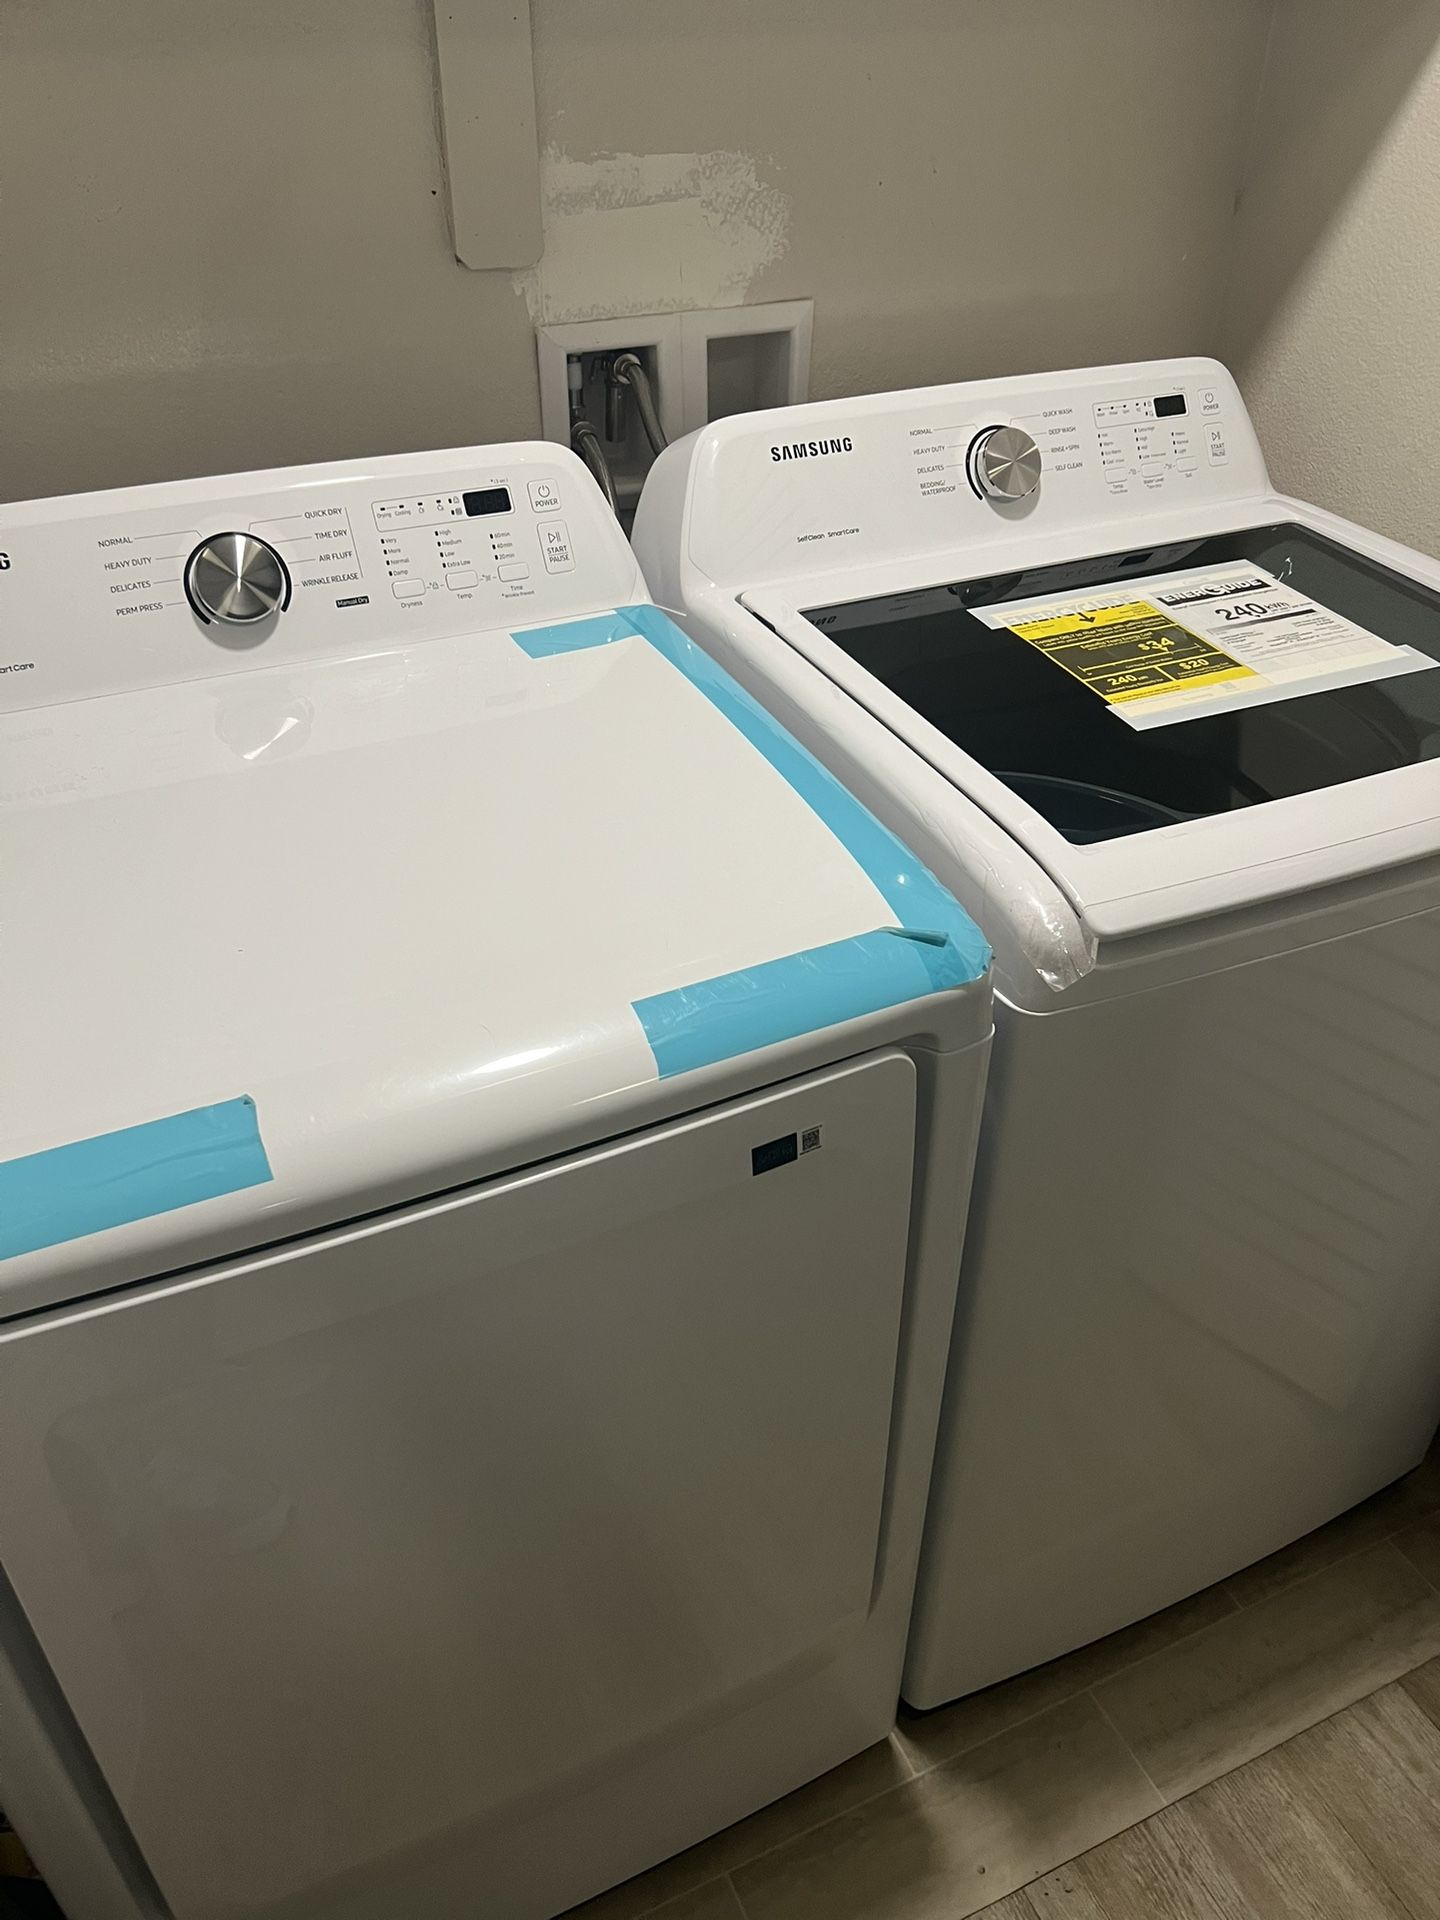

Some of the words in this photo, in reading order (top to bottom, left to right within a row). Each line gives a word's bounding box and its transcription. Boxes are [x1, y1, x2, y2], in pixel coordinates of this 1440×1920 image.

[909, 428, 933, 437] NORMAL
[770, 437, 853, 462] SAMSUNG
[913, 447, 932, 456] HEAVY
[932, 445, 946, 453] DUTY
[916, 464, 945, 474] DELICATES
[921, 485, 957, 497] WATERPROOF
[534, 497, 558, 508] POWER
[304, 509, 327, 519] QUICK
[327, 507, 343, 516] DRY
[314, 531, 333, 541] TIME
[333, 529, 348, 538] DRY
[98, 536, 134, 548] NORMAL
[319, 553, 331, 562] AIR
[331, 550, 353, 560] FLUFF
[546, 545, 568, 555] START
[104, 559, 132, 571] HEAVY
[131, 557, 152, 568] DUTY
[548, 554, 571, 563] PAUSE
[301, 575, 330, 588] WRINKLE
[330, 572, 359, 583] RELEASE
[110, 580, 152, 593] DELICATES
[1161, 579, 1264, 604] ENERGUIDE
[115, 604, 139, 616] PERM
[139, 601, 164, 612] PRESS
[400, 601, 423, 609] Dryness
[1214, 602, 1269, 622] 240
[1265, 600, 1290, 610] kWh
[1138, 637, 1175, 651] $34
[1179, 658, 1210, 670] $20
[1107, 674, 1138, 686] 240
